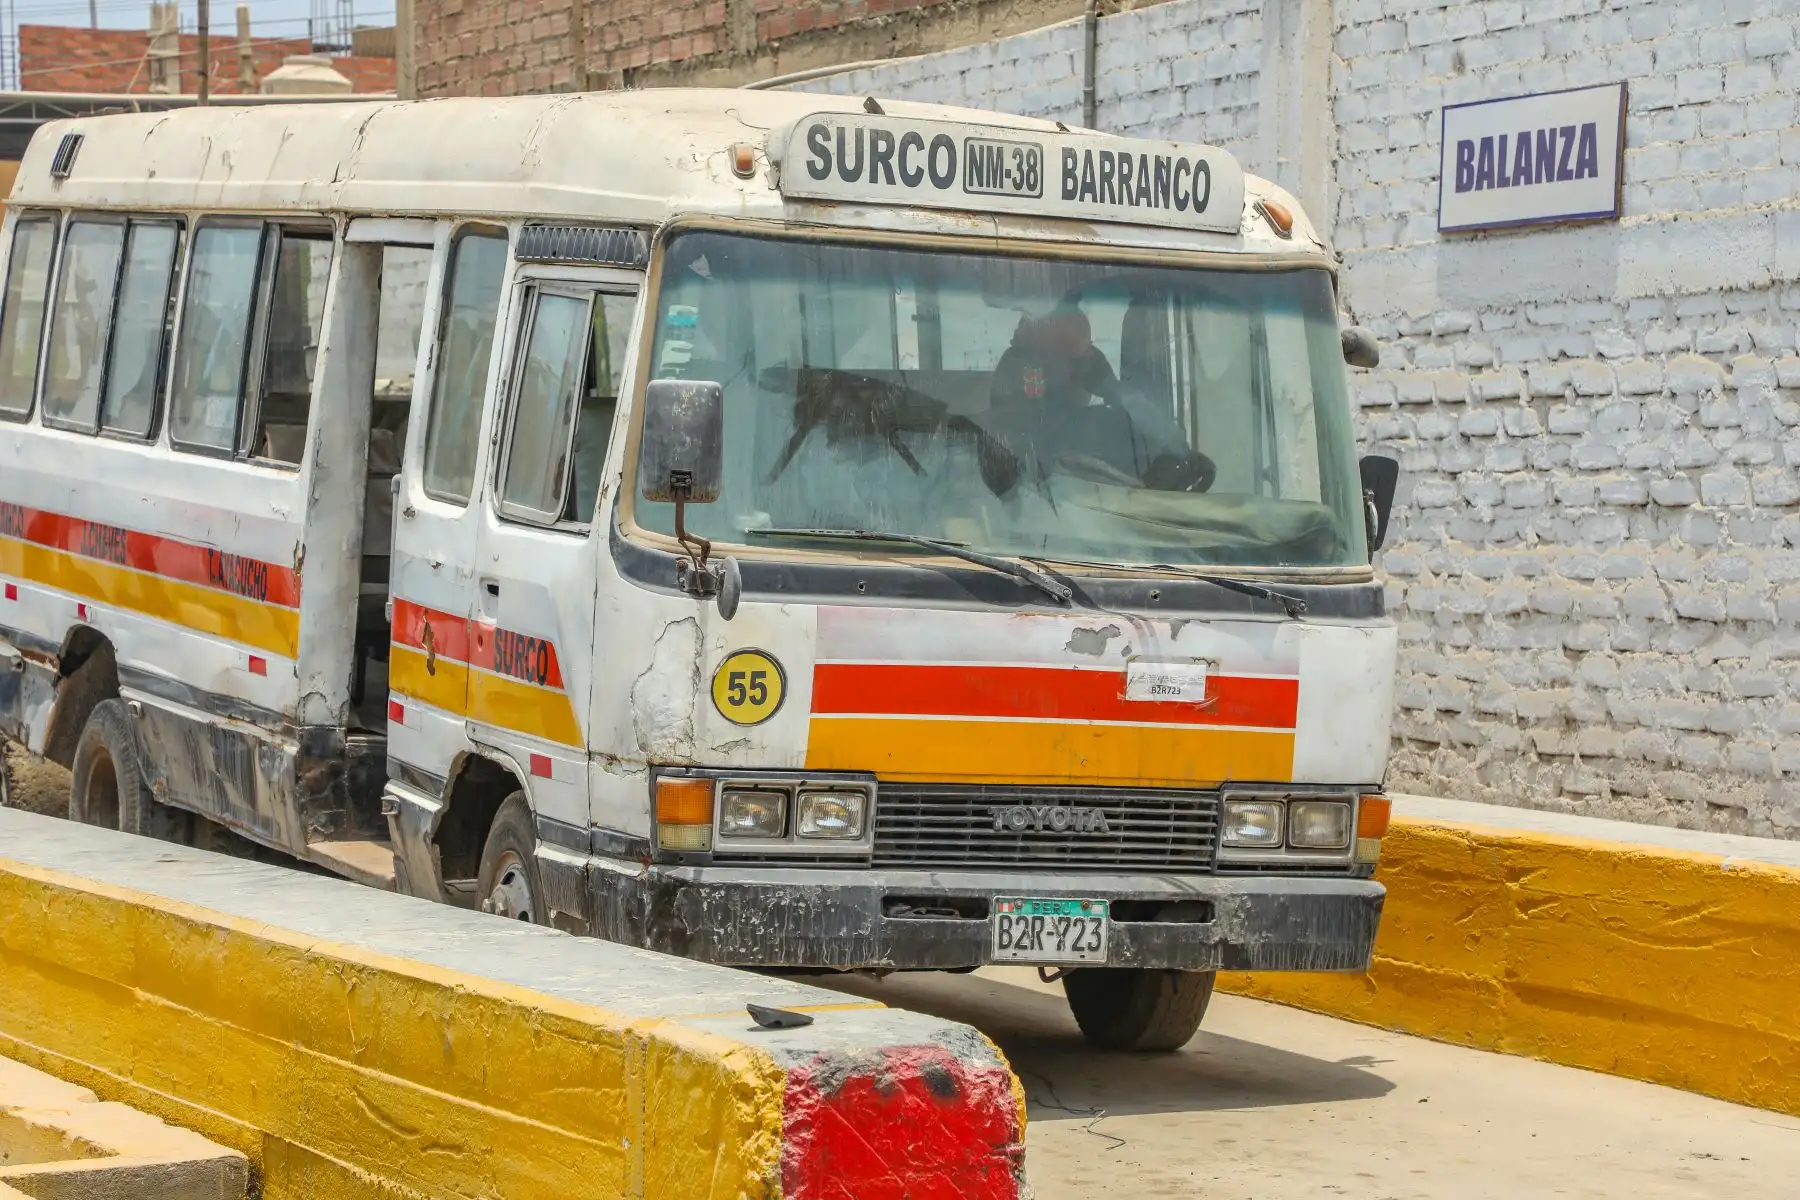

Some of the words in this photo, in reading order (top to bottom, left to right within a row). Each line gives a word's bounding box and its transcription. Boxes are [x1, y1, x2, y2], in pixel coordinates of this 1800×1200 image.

[806, 123, 957, 190] SURCO
[968, 145, 1039, 193] NM-38
[1061, 147, 1210, 214] BARRANCO
[1455, 122, 1598, 193] BALANZA
[493, 628, 548, 686] SURCO
[727, 671, 768, 706] 55
[1151, 686, 1181, 695] B2R723
[988, 806, 1109, 832] TOYOTA
